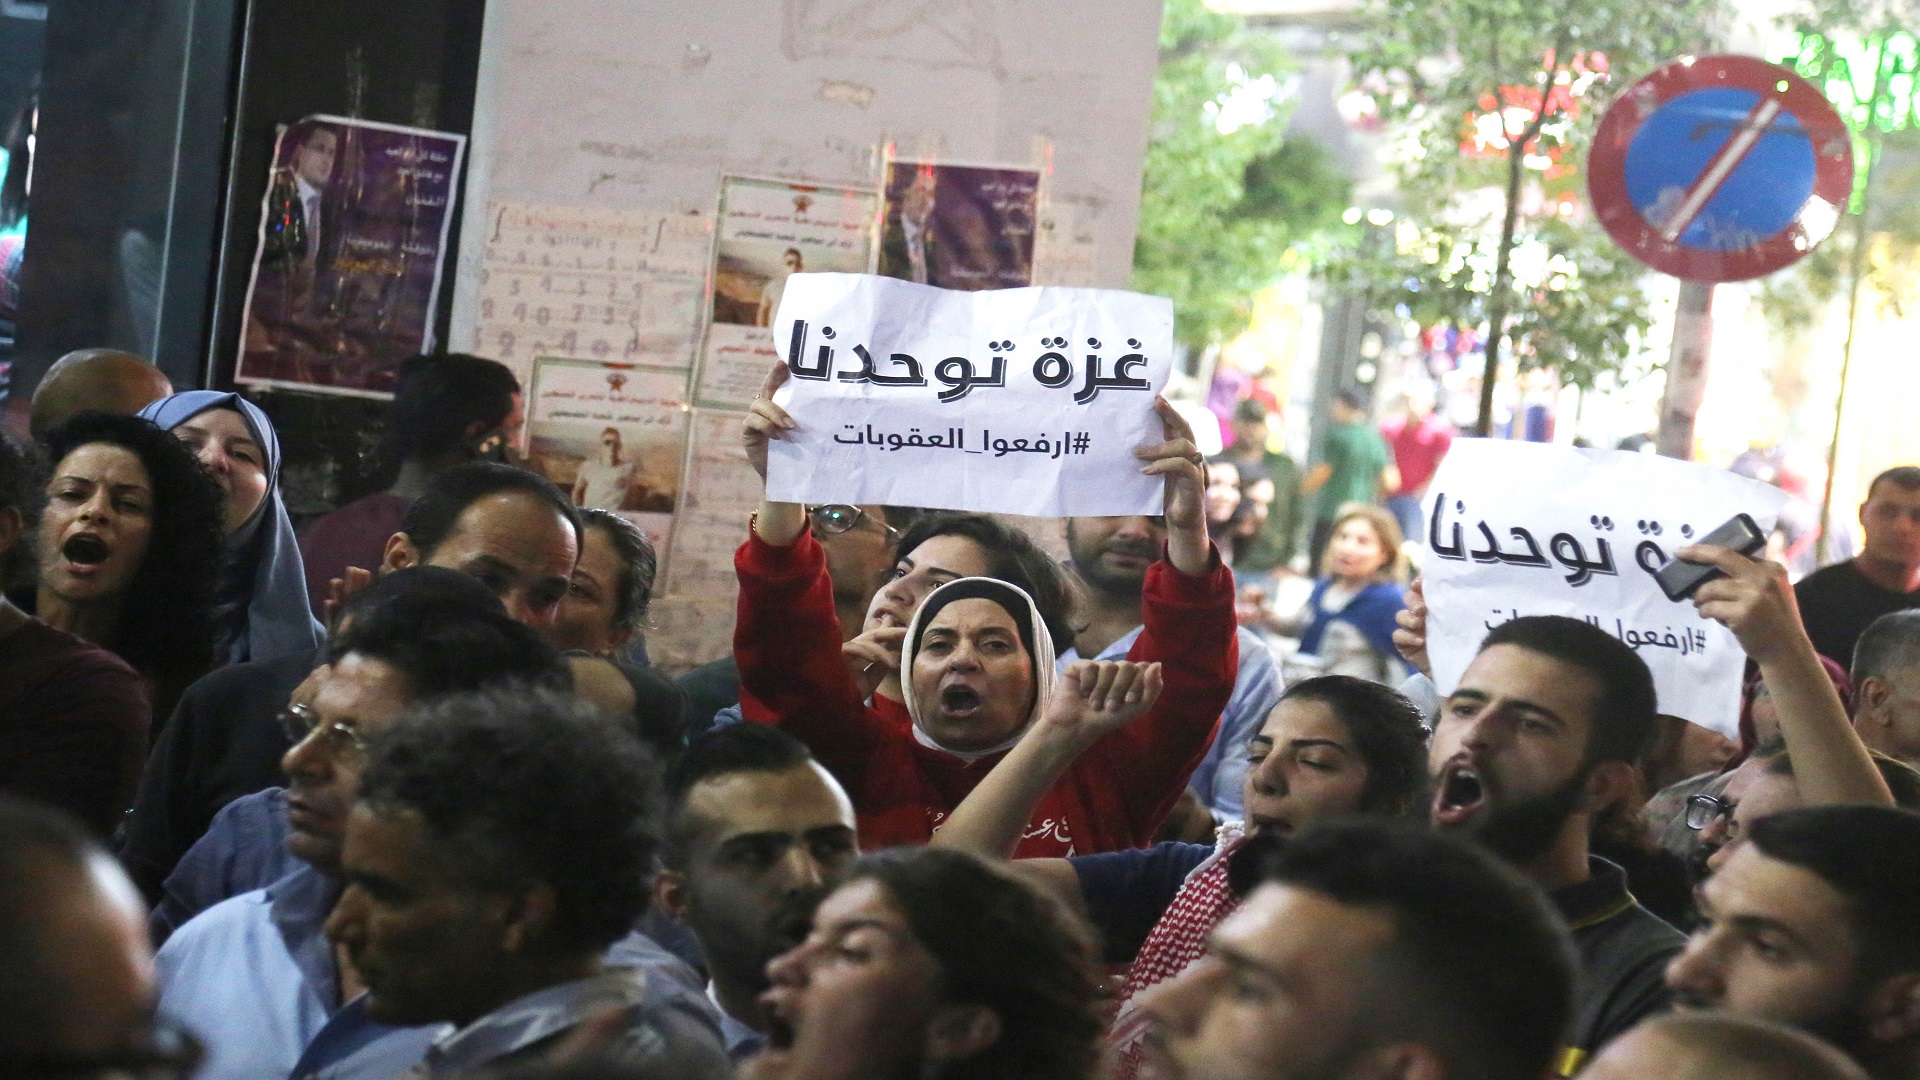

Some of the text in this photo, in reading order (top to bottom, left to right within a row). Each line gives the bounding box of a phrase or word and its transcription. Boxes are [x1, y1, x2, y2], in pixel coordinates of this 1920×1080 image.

[788, 320, 1016, 404] توحدنا
[1032, 336, 1151, 405] غزة
[833, 424, 1091, 460] #ارفعوا_العقوبات
[1430, 492, 1618, 587] توحدنا
